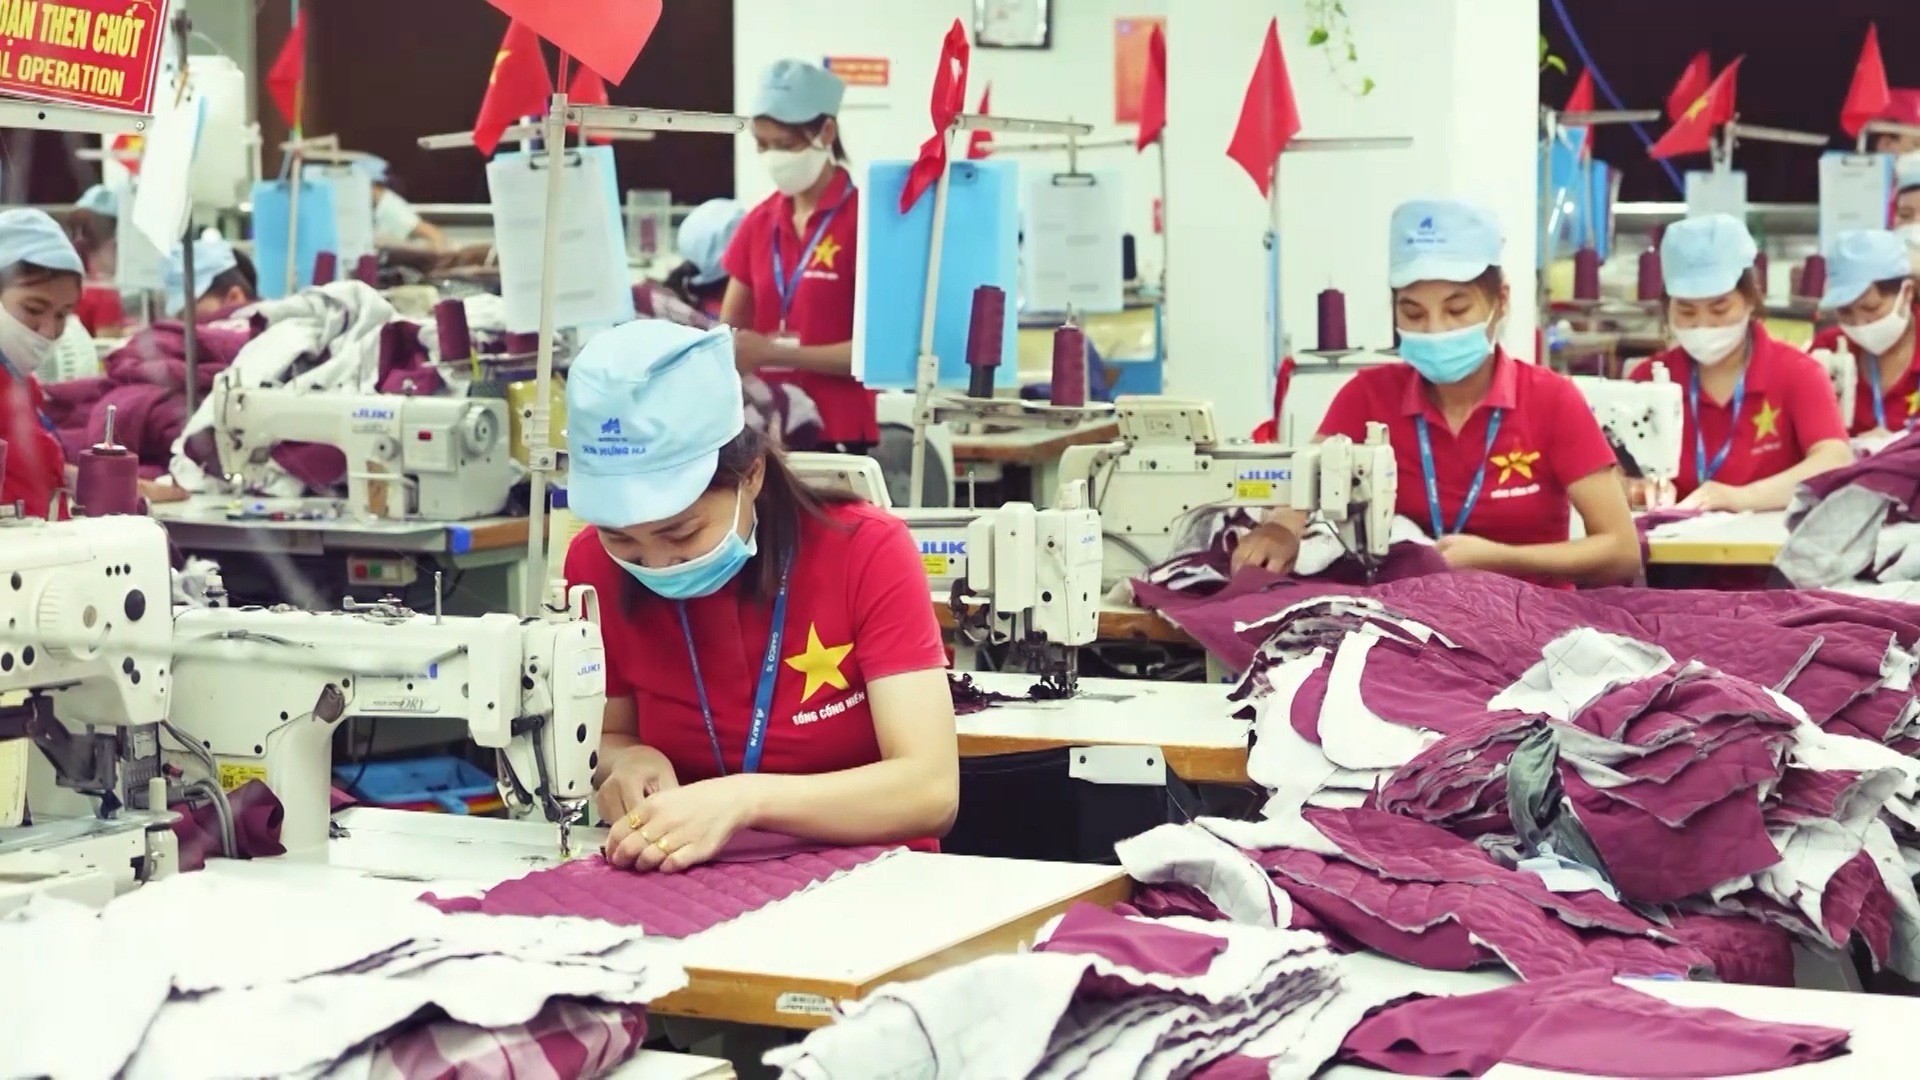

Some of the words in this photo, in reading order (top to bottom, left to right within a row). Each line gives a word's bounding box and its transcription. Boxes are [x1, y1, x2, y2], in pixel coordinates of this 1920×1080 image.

[40, 3, 91, 50] THEN
[92, 3, 145, 58] CHỐT
[17, 54, 125, 97] OPERATION
[1239, 471, 1292, 480] JUKI
[577, 663, 600, 676] JUKI
